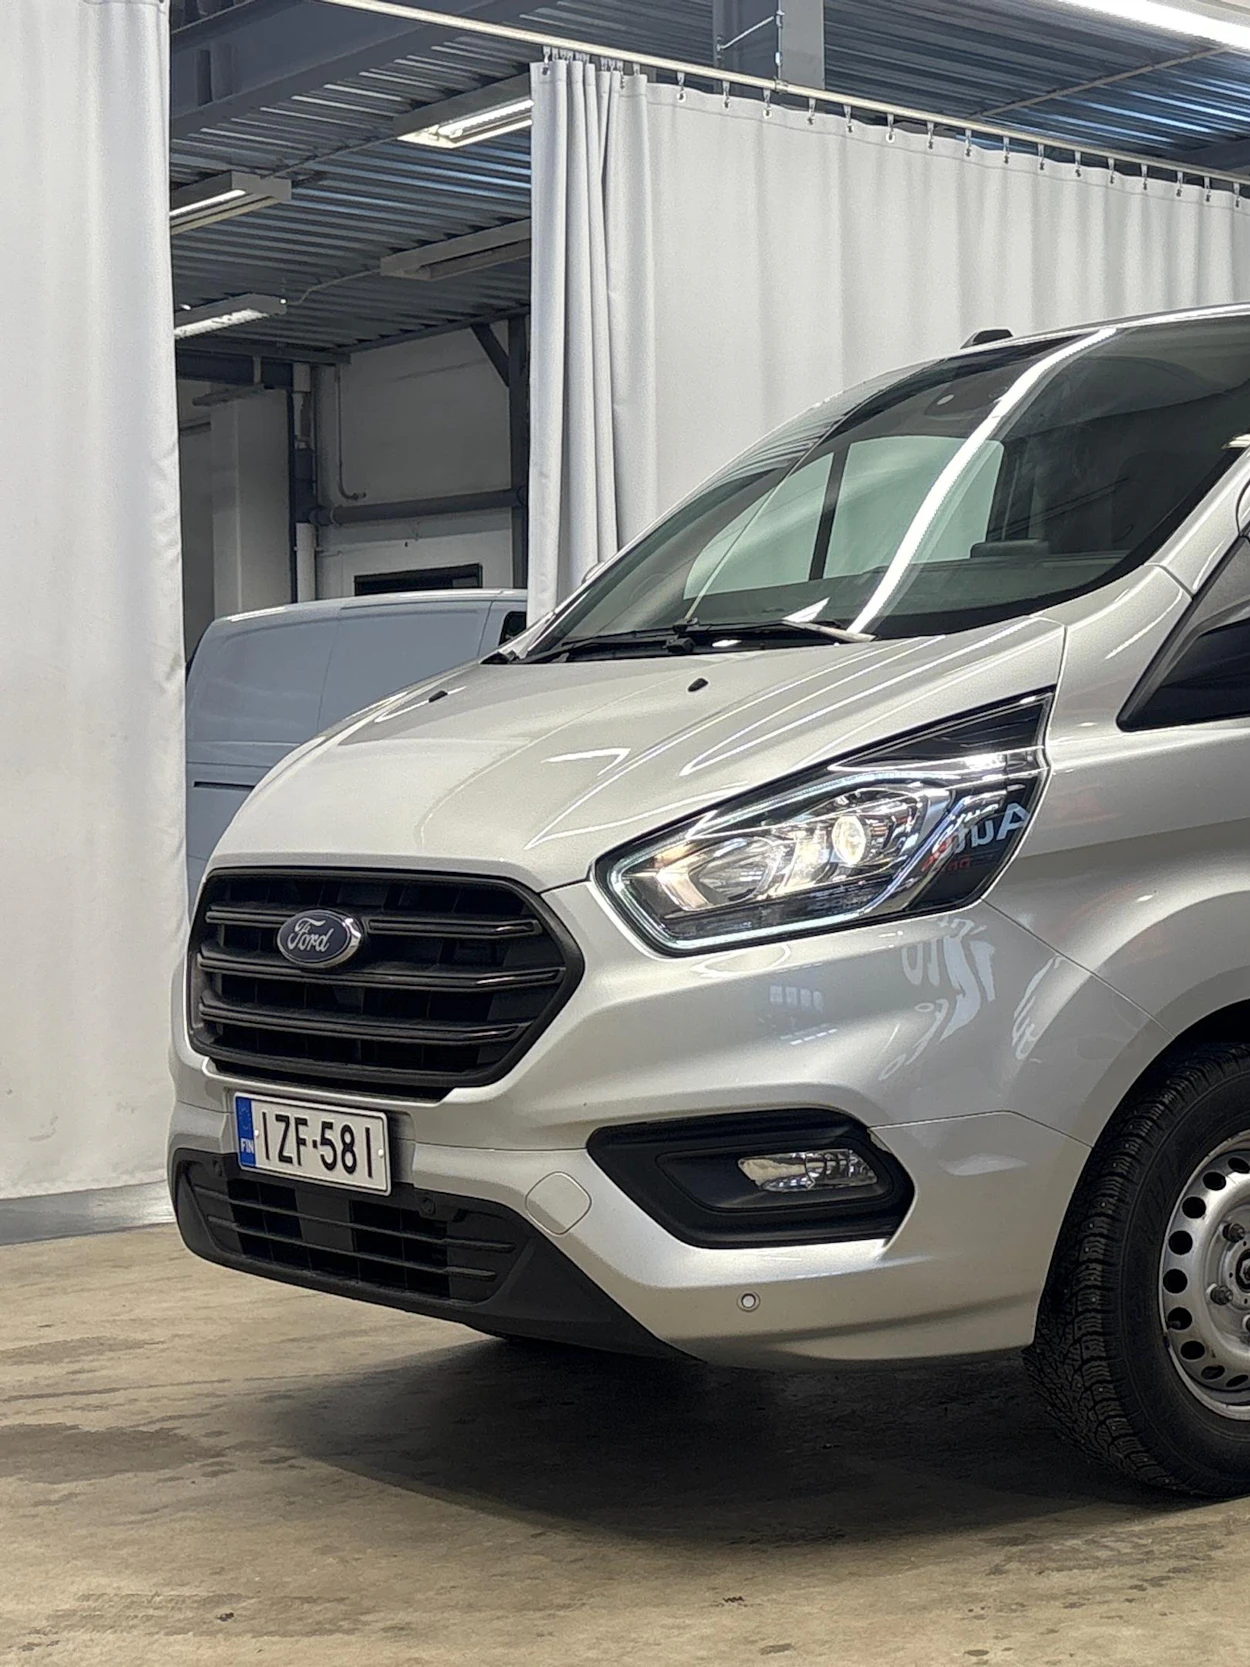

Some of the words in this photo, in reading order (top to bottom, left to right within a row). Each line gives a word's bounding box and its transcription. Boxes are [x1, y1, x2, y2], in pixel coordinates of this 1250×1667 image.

[287, 917, 334, 952] Ford
[241, 1138, 255, 1154] FIN
[262, 1111, 373, 1179] IZF-581
